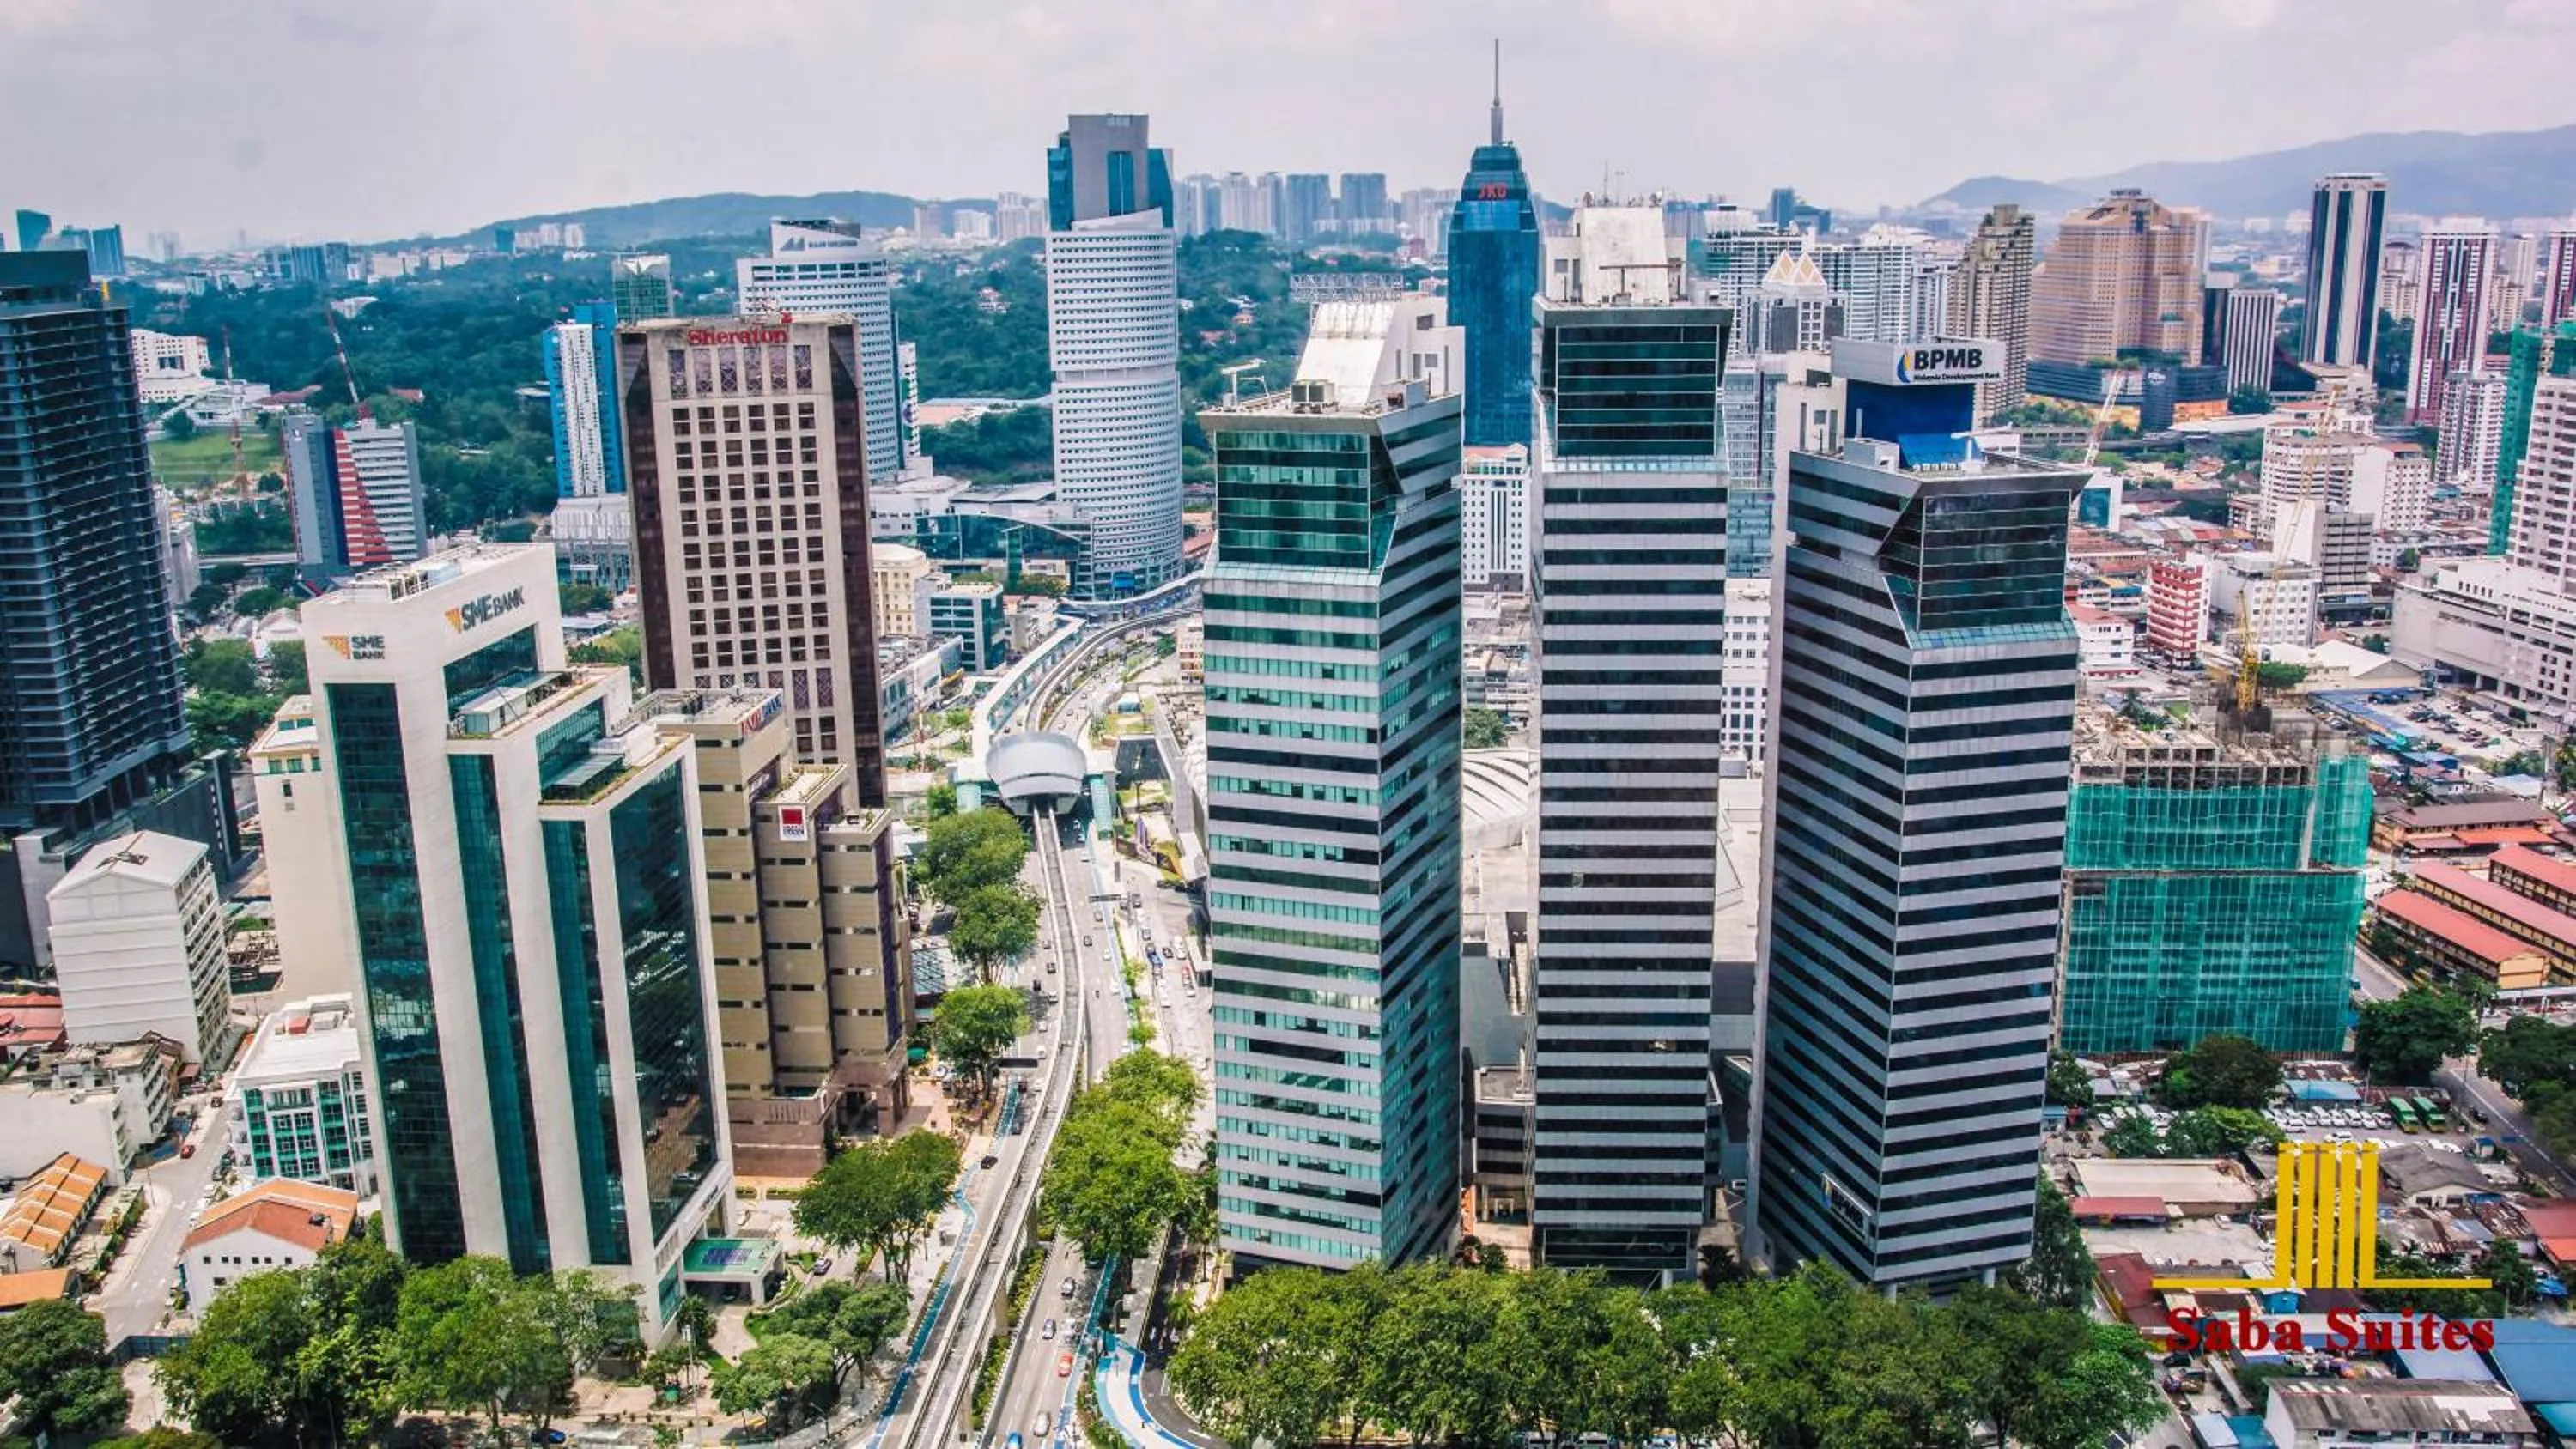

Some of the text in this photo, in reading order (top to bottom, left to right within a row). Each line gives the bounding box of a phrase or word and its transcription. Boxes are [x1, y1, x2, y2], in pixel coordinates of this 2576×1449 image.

[688, 327, 788, 346] Sheraton
[1914, 349, 1983, 370] BPMB
[462, 585, 525, 631] SME BANK
[351, 635, 386, 649] SME
[353, 651, 386, 660] BANK
